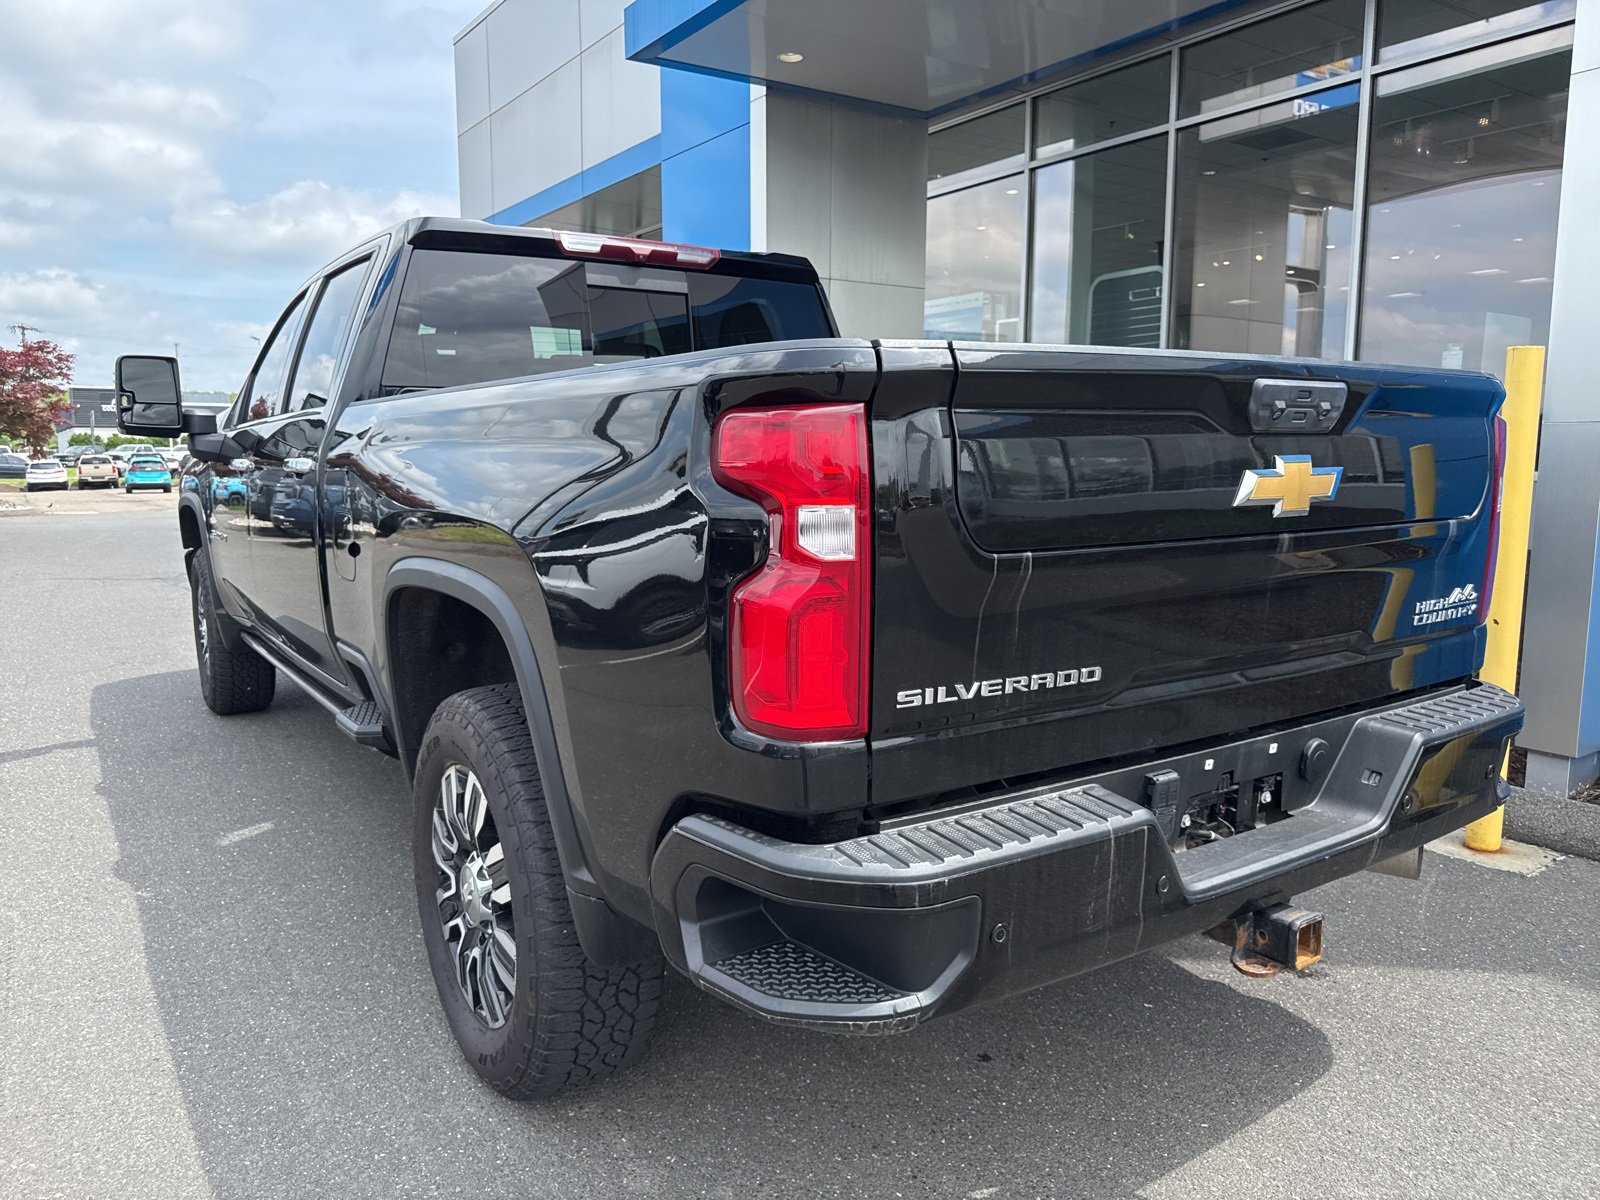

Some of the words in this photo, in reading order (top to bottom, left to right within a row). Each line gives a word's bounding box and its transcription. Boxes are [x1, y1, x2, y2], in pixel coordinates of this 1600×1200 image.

[1413, 604, 1477, 626] COUNTRY
[1415, 598, 1450, 614] HIGH
[896, 666, 1102, 709] SILVERADO
